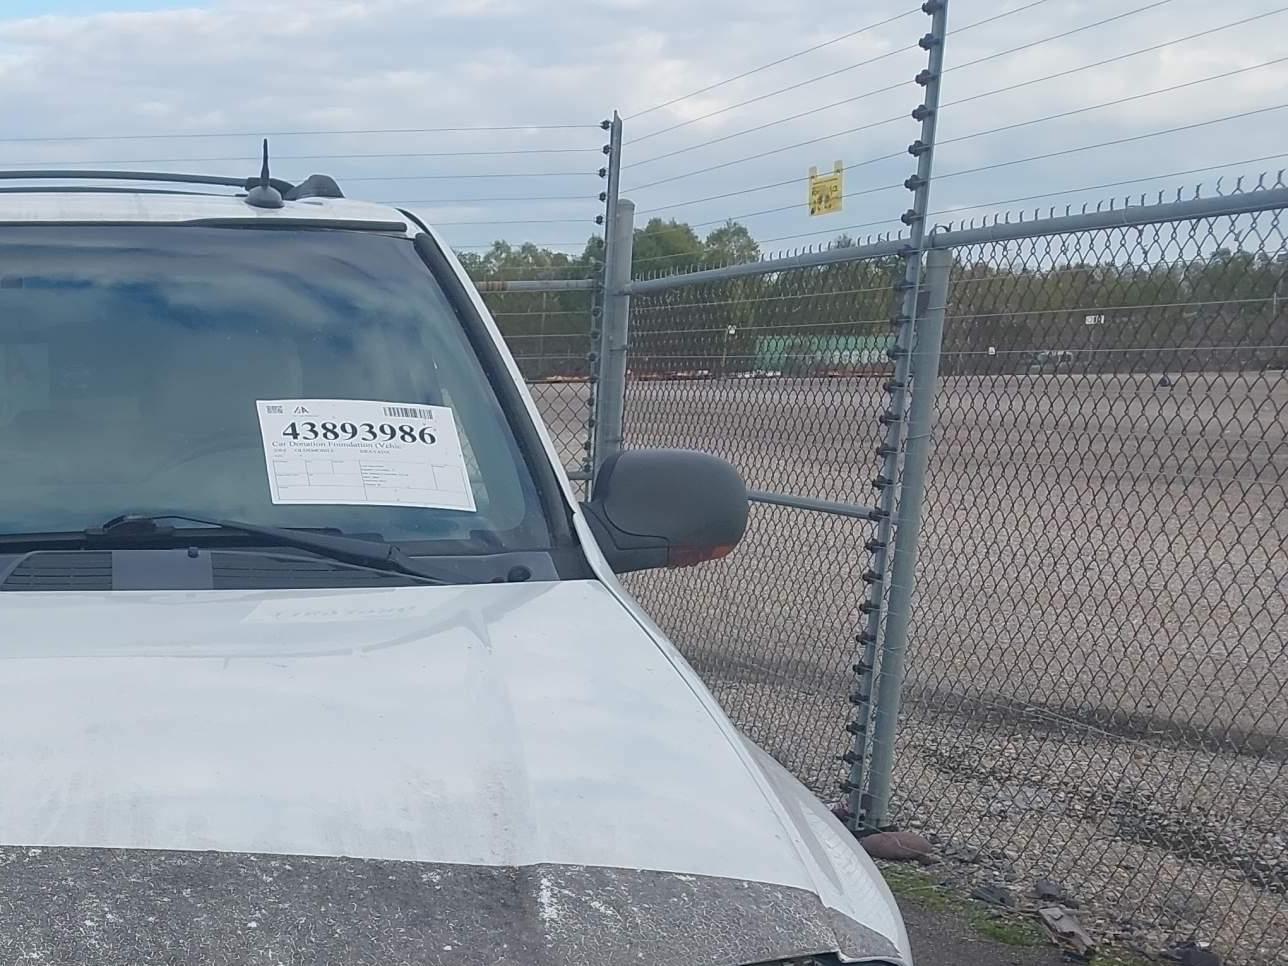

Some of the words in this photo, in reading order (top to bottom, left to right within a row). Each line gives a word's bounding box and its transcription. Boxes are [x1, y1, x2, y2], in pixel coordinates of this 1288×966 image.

[282, 421, 437, 445] 43893986
[289, 440, 327, 448] Donation
[328, 441, 373, 449] Foundation
